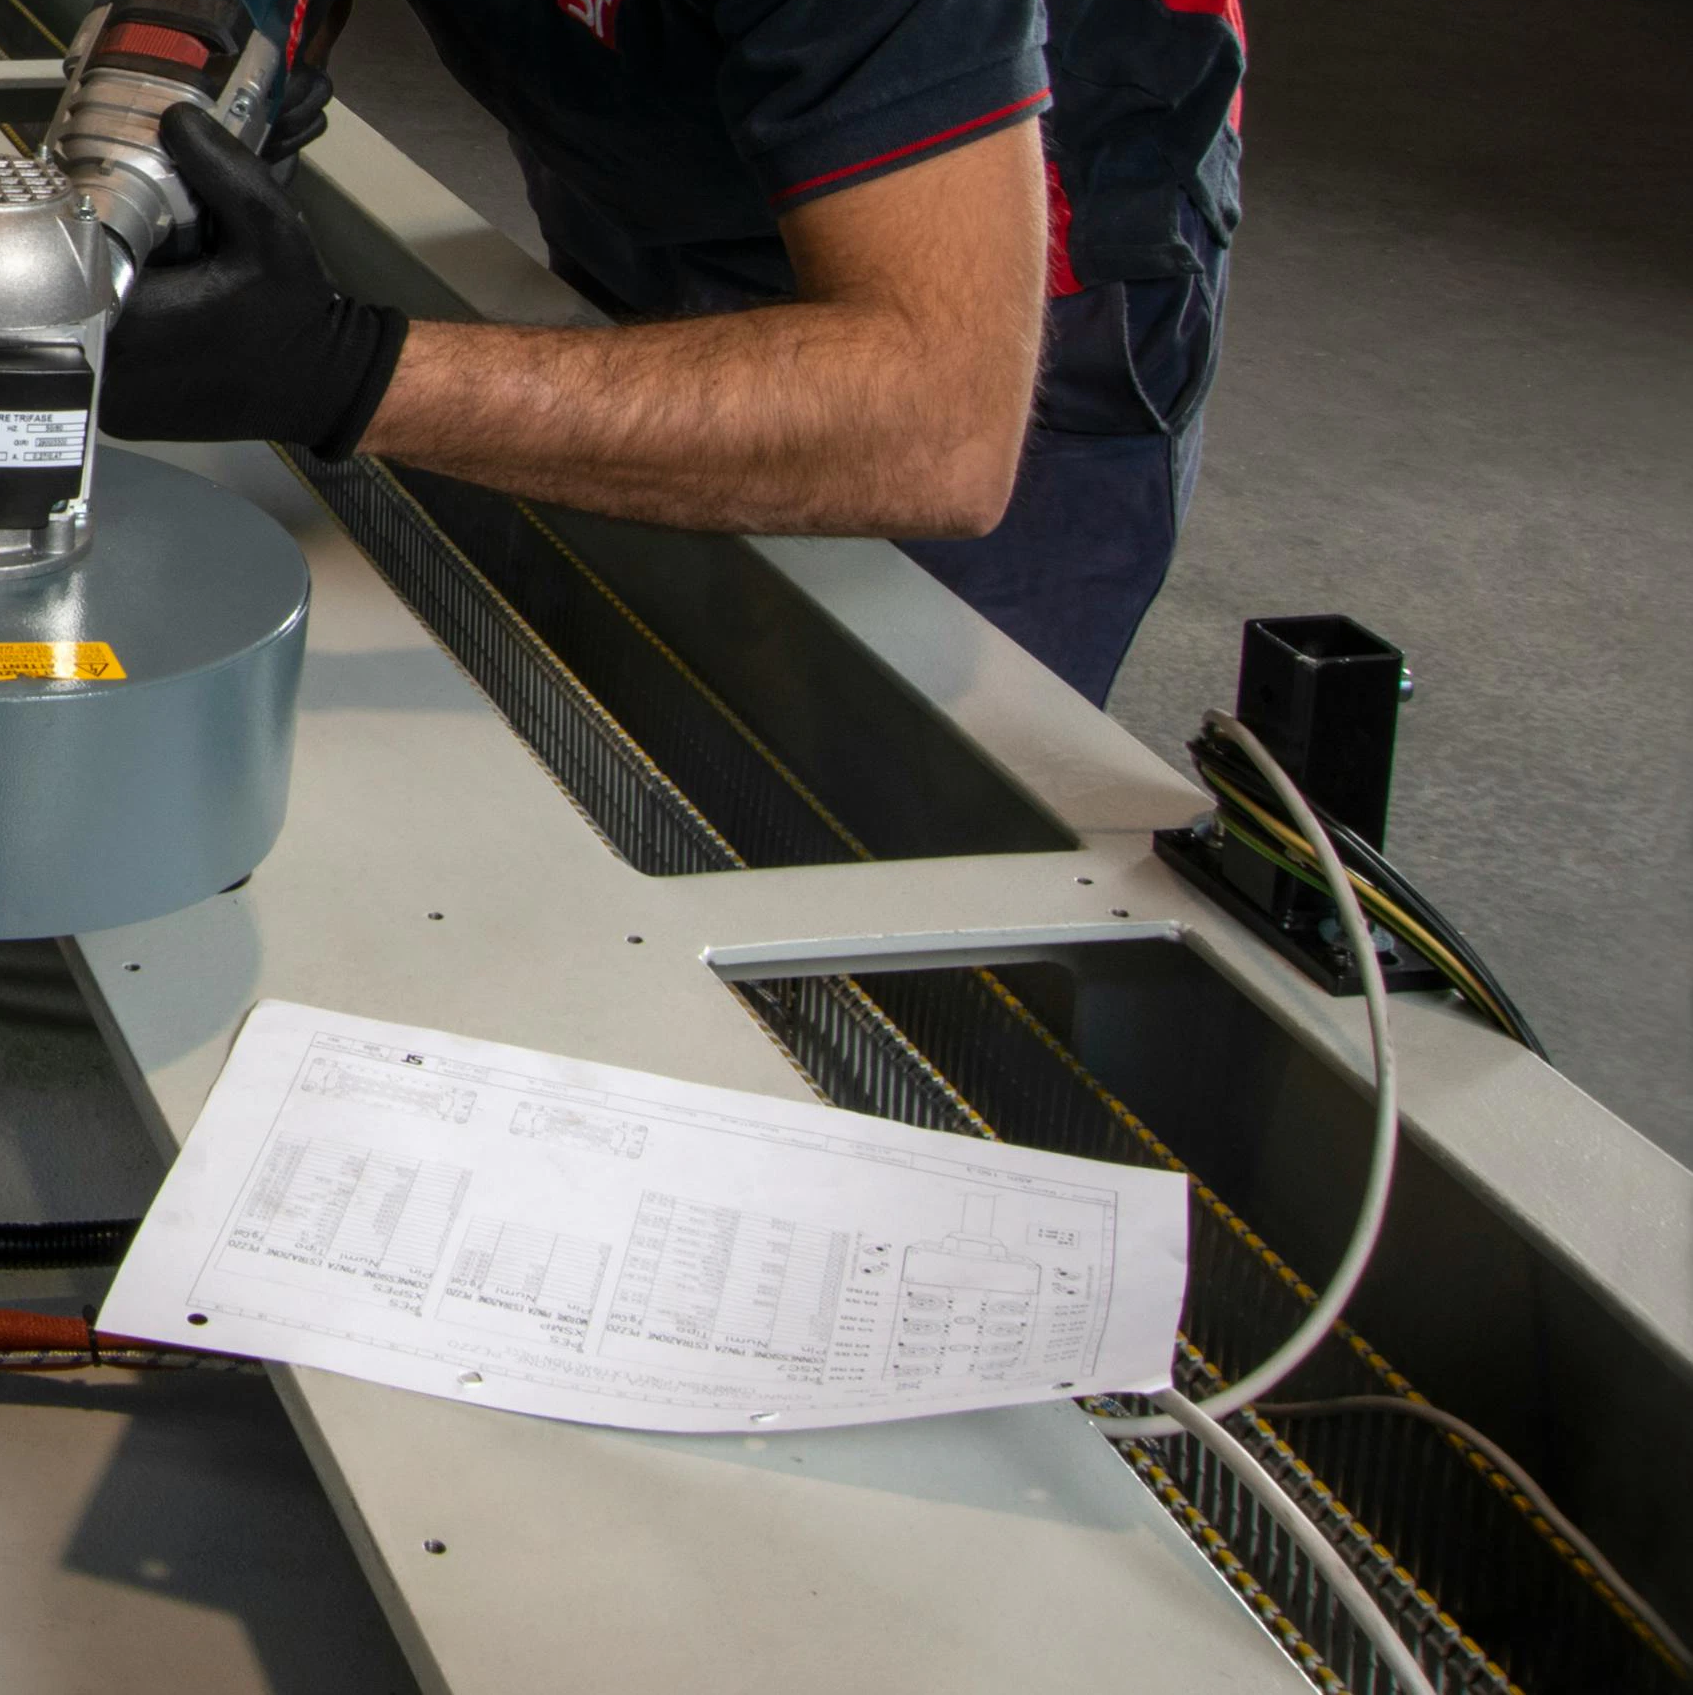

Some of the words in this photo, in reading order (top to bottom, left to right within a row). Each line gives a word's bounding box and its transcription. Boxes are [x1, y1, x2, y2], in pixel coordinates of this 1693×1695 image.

[14, 413, 53, 423] TRIFASE
[227, 1238, 259, 1252] PEZZO
[263, 1246, 323, 1266] ESTRAZIONE
[326, 1261, 356, 1274] PINZA
[361, 1268, 428, 1289] CONNESSIONE
[445, 1287, 472, 1299] PEZZO
[606, 1324, 640, 1336] PEZZO
[646, 1331, 708, 1349] ESTRAZIONE
[714, 1344, 745, 1355] PINZA
